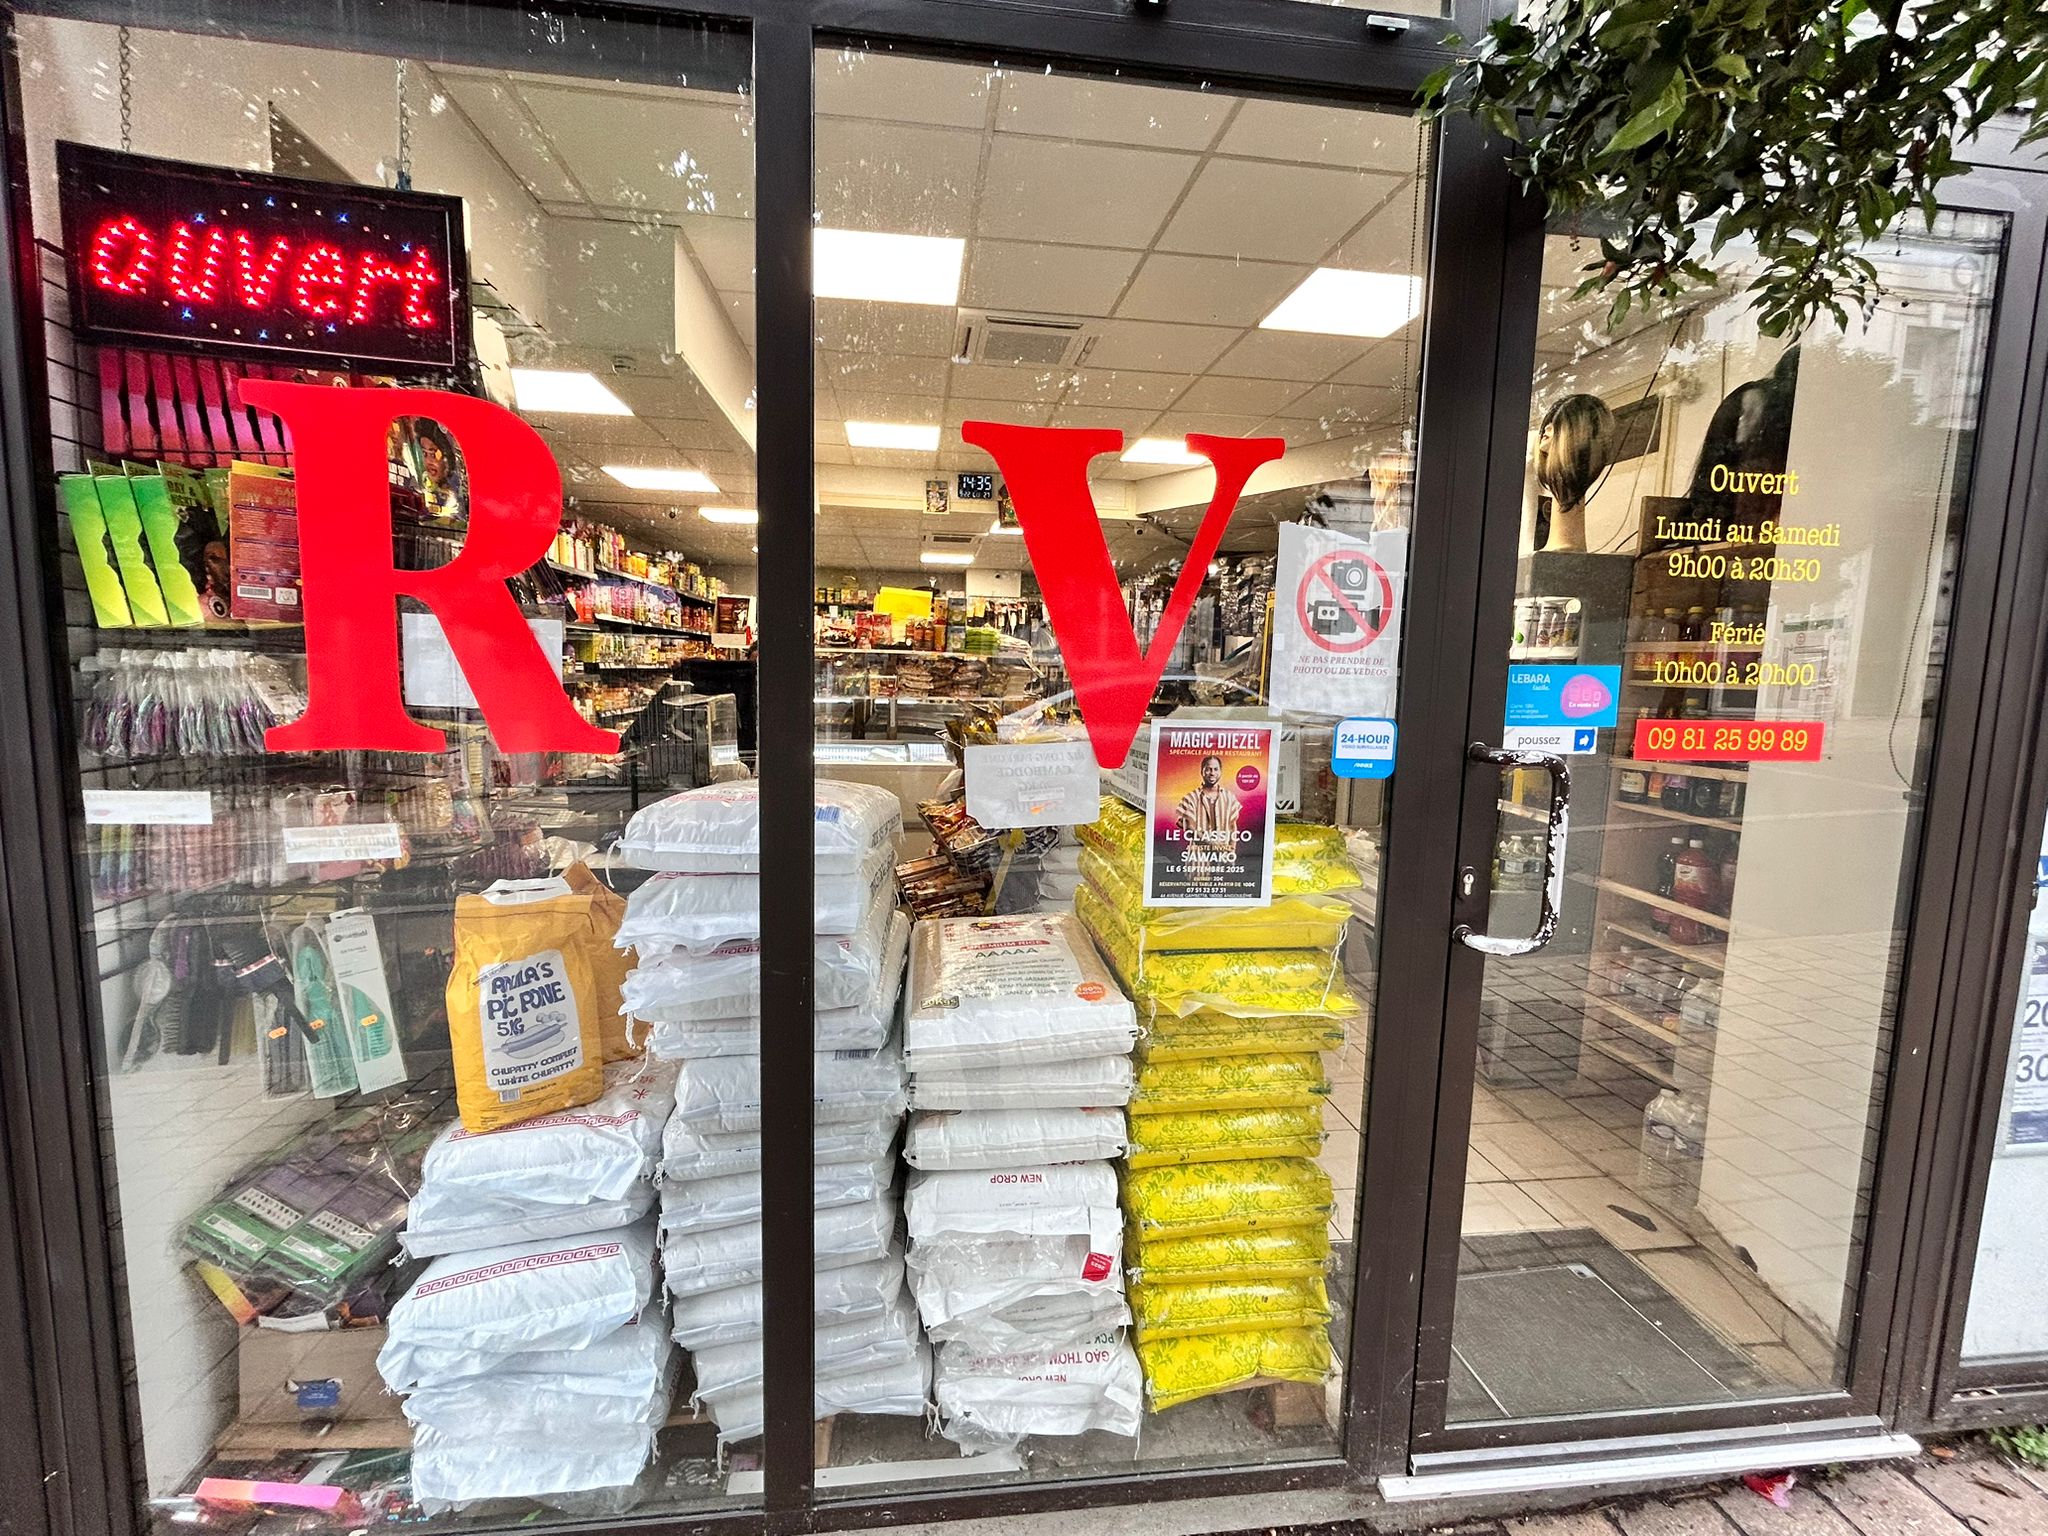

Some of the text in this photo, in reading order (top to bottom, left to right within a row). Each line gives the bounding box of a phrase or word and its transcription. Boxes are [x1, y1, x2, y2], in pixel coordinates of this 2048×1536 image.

[90, 215, 439, 326] ouvert
[1710, 463, 1800, 495] Ouvert
[1655, 515, 1841, 547] Lundi au Samedi
[238, 379, 1285, 768] R V
[1668, 553, 1821, 582] 9h00 à 20h30
[1708, 621, 1766, 645] Férié
[1293, 666, 1323, 674] PHOTO
[1324, 666, 1337, 675] OU
[1339, 667, 1353, 676] DE
[1312, 656, 1329, 664] PAS
[1330, 656, 1371, 666] PRENDRE
[1372, 658, 1385, 666] DE
[1511, 673, 1551, 684] LEBARA
[1652, 660, 1815, 687] 10h00 à 20h00
[1170, 731, 1261, 750] MAGIC DIEZEL
[1341, 733, 1390, 745] 24-HOUR
[1518, 736, 1560, 748] poussez
[1647, 727, 1808, 752] 09 81 25 99 89
[1166, 830, 1252, 842] LE CLASSICO
[1181, 851, 1237, 864] SAWAKO
[1166, 865, 1176, 873] LE
[975, 947, 1039, 958] AAAAA
[520, 981, 566, 1014] PONE
[497, 1017, 525, 1037] 5KG
[491, 1046, 578, 1077] CHUPATTY COMPLET
[532, 1058, 576, 1081] CHUPATTY
[990, 1173, 1043, 1184] NEW CROP
